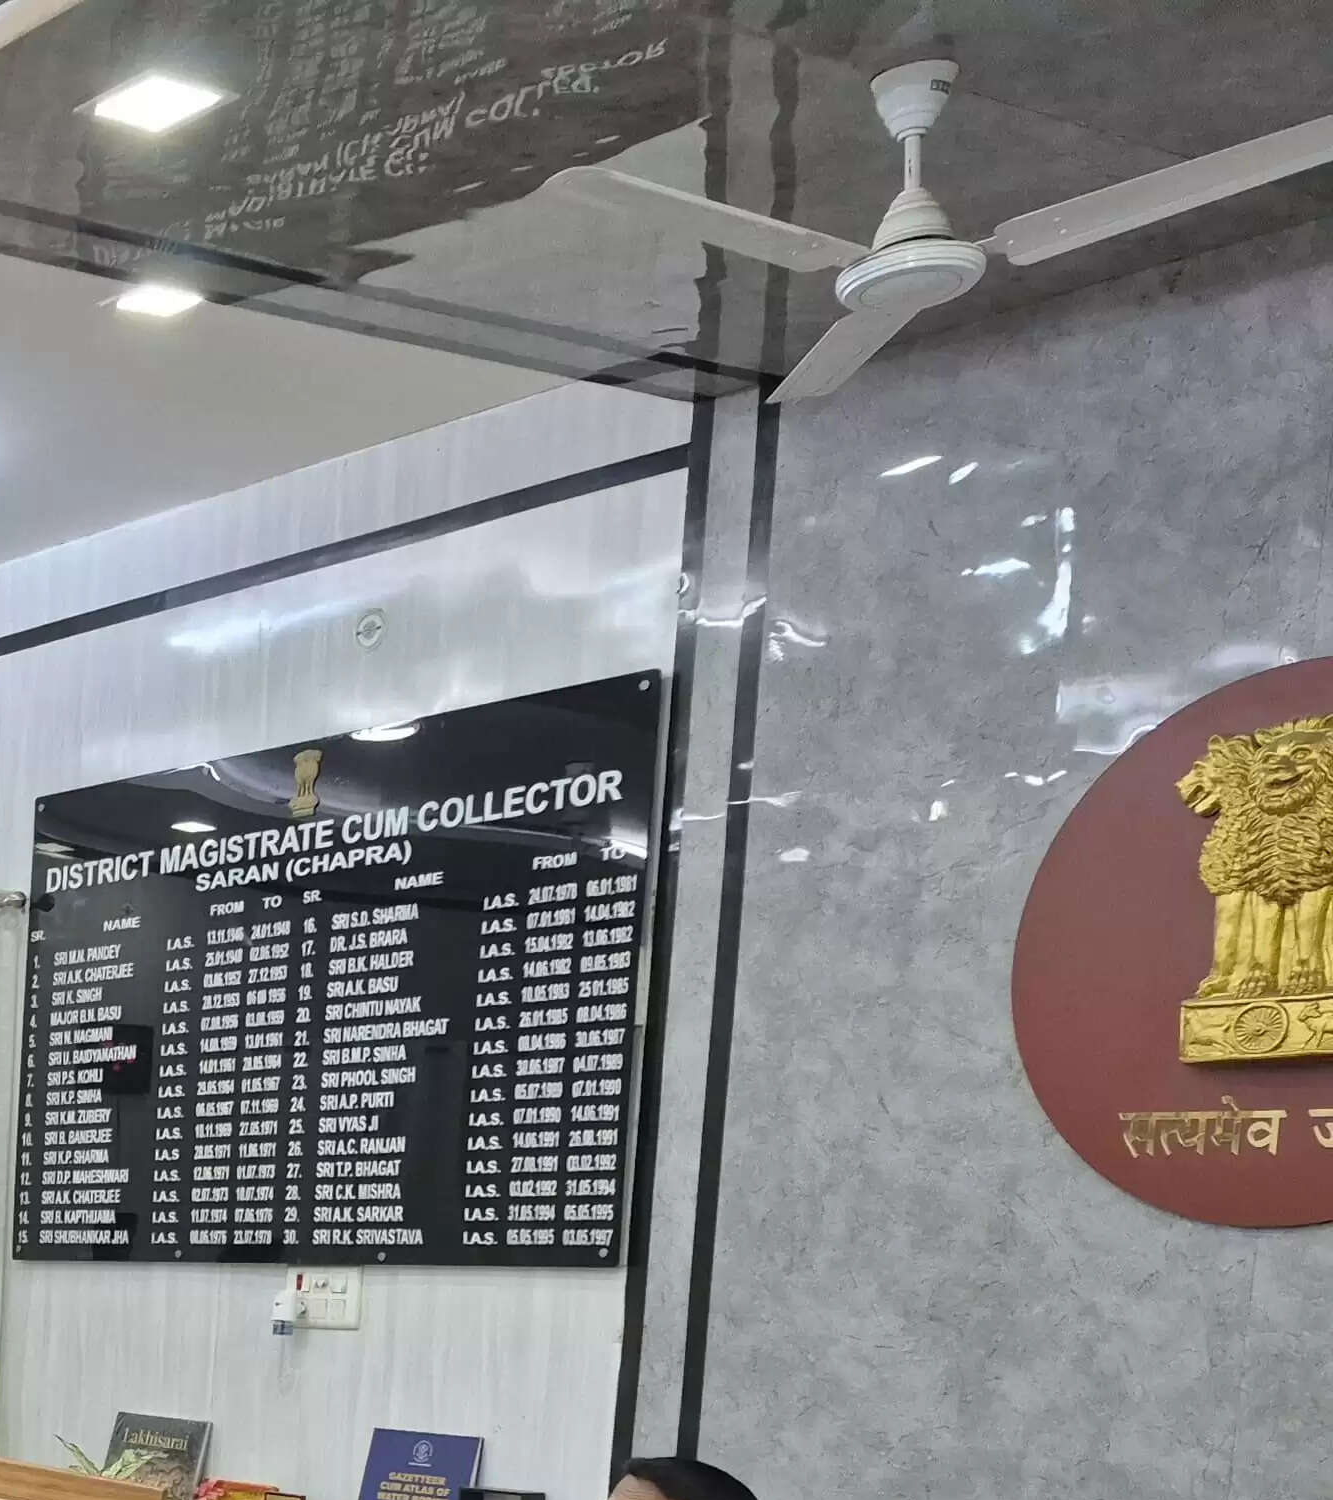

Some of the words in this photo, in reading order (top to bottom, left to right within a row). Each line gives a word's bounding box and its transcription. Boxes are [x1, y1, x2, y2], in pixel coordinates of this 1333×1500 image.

[44, 849, 155, 893] DISTRICT
[159, 818, 334, 875] MAGISTRATE
[341, 804, 409, 844] CUM
[415, 768, 623, 832] COLLECTOR
[194, 861, 279, 892] SARAN
[284, 839, 412, 882] (CHAPRA)
[102, 915, 141, 932] NAME
[209, 899, 245, 916] FROM
[261, 894, 283, 909] TO
[393, 870, 444, 891] NAME
[531, 850, 577, 870] FROM
[598, 844, 625, 862] TO
[302, 916, 317, 934] 16.
[330, 911, 350, 930] SRI
[371, 902, 419, 924] SHARMA
[482, 891, 519, 911] I.A.S.
[86, 943, 121, 961] PANDEY
[165, 935, 195, 951] I.A.S.
[300, 938, 316, 957] 17.
[328, 934, 347, 953] DR.
[368, 927, 408, 948] BRARA
[479, 917, 517, 935] I.A.S.
[165, 956, 193, 972] I.A.S.
[299, 961, 314, 979] 18.
[327, 957, 346, 976] SRI
[369, 949, 414, 970] HALDER
[478, 941, 516, 959] I.A.S.
[75, 986, 102, 1003] SINGH
[163, 978, 192, 993] I.A.S.
[297, 983, 313, 1001] 19.
[325, 980, 345, 998] SRI
[367, 974, 399, 994] BASU
[476, 966, 514, 983] I.A.S.
[97, 1004, 122, 1021] BASU
[162, 999, 190, 1014] I.A.S.
[294, 1006, 311, 1023] 20.
[324, 1003, 343, 1021] SRI
[344, 999, 383, 1018] CHINTU
[384, 995, 422, 1015] NAYAK
[475, 990, 512, 1007] I.A.S.
[161, 1020, 189, 1036] I.A.S.
[293, 1029, 310, 1047] 21.
[322, 1026, 341, 1044] SRI
[342, 1022, 401, 1041] NARENDRA
[401, 1017, 450, 1038] BHAGAT
[473, 1014, 511, 1032] I.A.S.
[159, 1041, 188, 1057] I.A.S.
[292, 1050, 309, 1068] 22.
[321, 1048, 340, 1066] SRI
[372, 1043, 407, 1062] SINHA
[472, 1038, 509, 1055] I.A.S.
[77, 1067, 103, 1083] KOHLI
[158, 1062, 187, 1078] I.A.S.
[290, 1073, 307, 1091] 23.
[319, 1071, 339, 1088] SRI
[340, 1069, 379, 1087] PHOOL
[380, 1065, 416, 1084] SINGH
[471, 1062, 507, 1079] I.A.S.
[157, 1083, 185, 1098] I.A.S.
[289, 1095, 306, 1113] 24.
[318, 1093, 338, 1111] SRI
[360, 1090, 394, 1108] PURTI
[469, 1087, 506, 1103] I.A.S.
[156, 1105, 184, 1119] I.A.S.
[287, 1117, 305, 1135] 25.
[317, 1116, 337, 1133] SRI
[338, 1114, 367, 1132] VYAS
[367, 1113, 379, 1131] JI
[467, 1111, 504, 1127] I.A.S.
[155, 1126, 183, 1141] I.A.S.
[1118, 1095, 1287, 1158] सत्यमेव
[153, 1147, 180, 1161] I.A.S
[286, 1139, 303, 1157] 26.
[316, 1138, 336, 1156] SRI
[335, 1137, 358, 1155] A.C.
[359, 1135, 406, 1154] RANJAN
[466, 1134, 503, 1151] I.A.S.
[152, 1168, 181, 1182] I.A.S.
[285, 1161, 302, 1179] 27.
[314, 1160, 334, 1178] SRI
[335, 1160, 353, 1177] T.P.
[354, 1158, 402, 1177] BHAGAT
[465, 1159, 502, 1174] I.A.S.
[72, 1187, 121, 1204] CHATERJEE
[151, 1189, 180, 1203] I.A.S.
[284, 1183, 301, 1201] 28.
[313, 1183, 333, 1200] SRI
[357, 1182, 401, 1200] MISHRA
[464, 1183, 501, 1198] I.A.S.
[151, 1210, 179, 1224] I.A.S.
[283, 1205, 300, 1222] 29.
[312, 1205, 332, 1222] SRI
[356, 1204, 404, 1222] SARKAR
[463, 1206, 499, 1221] I.A.S.
[110, 1228, 129, 1245] JHA
[150, 1231, 179, 1244] I.A.S.
[282, 1228, 299, 1245] 30.
[311, 1228, 331, 1245] SRI
[354, 1227, 423, 1245] SRIVASTAVA
[461, 1230, 498, 1246] I.A.S.
[122, 1427, 189, 1451] Lakhisarai
